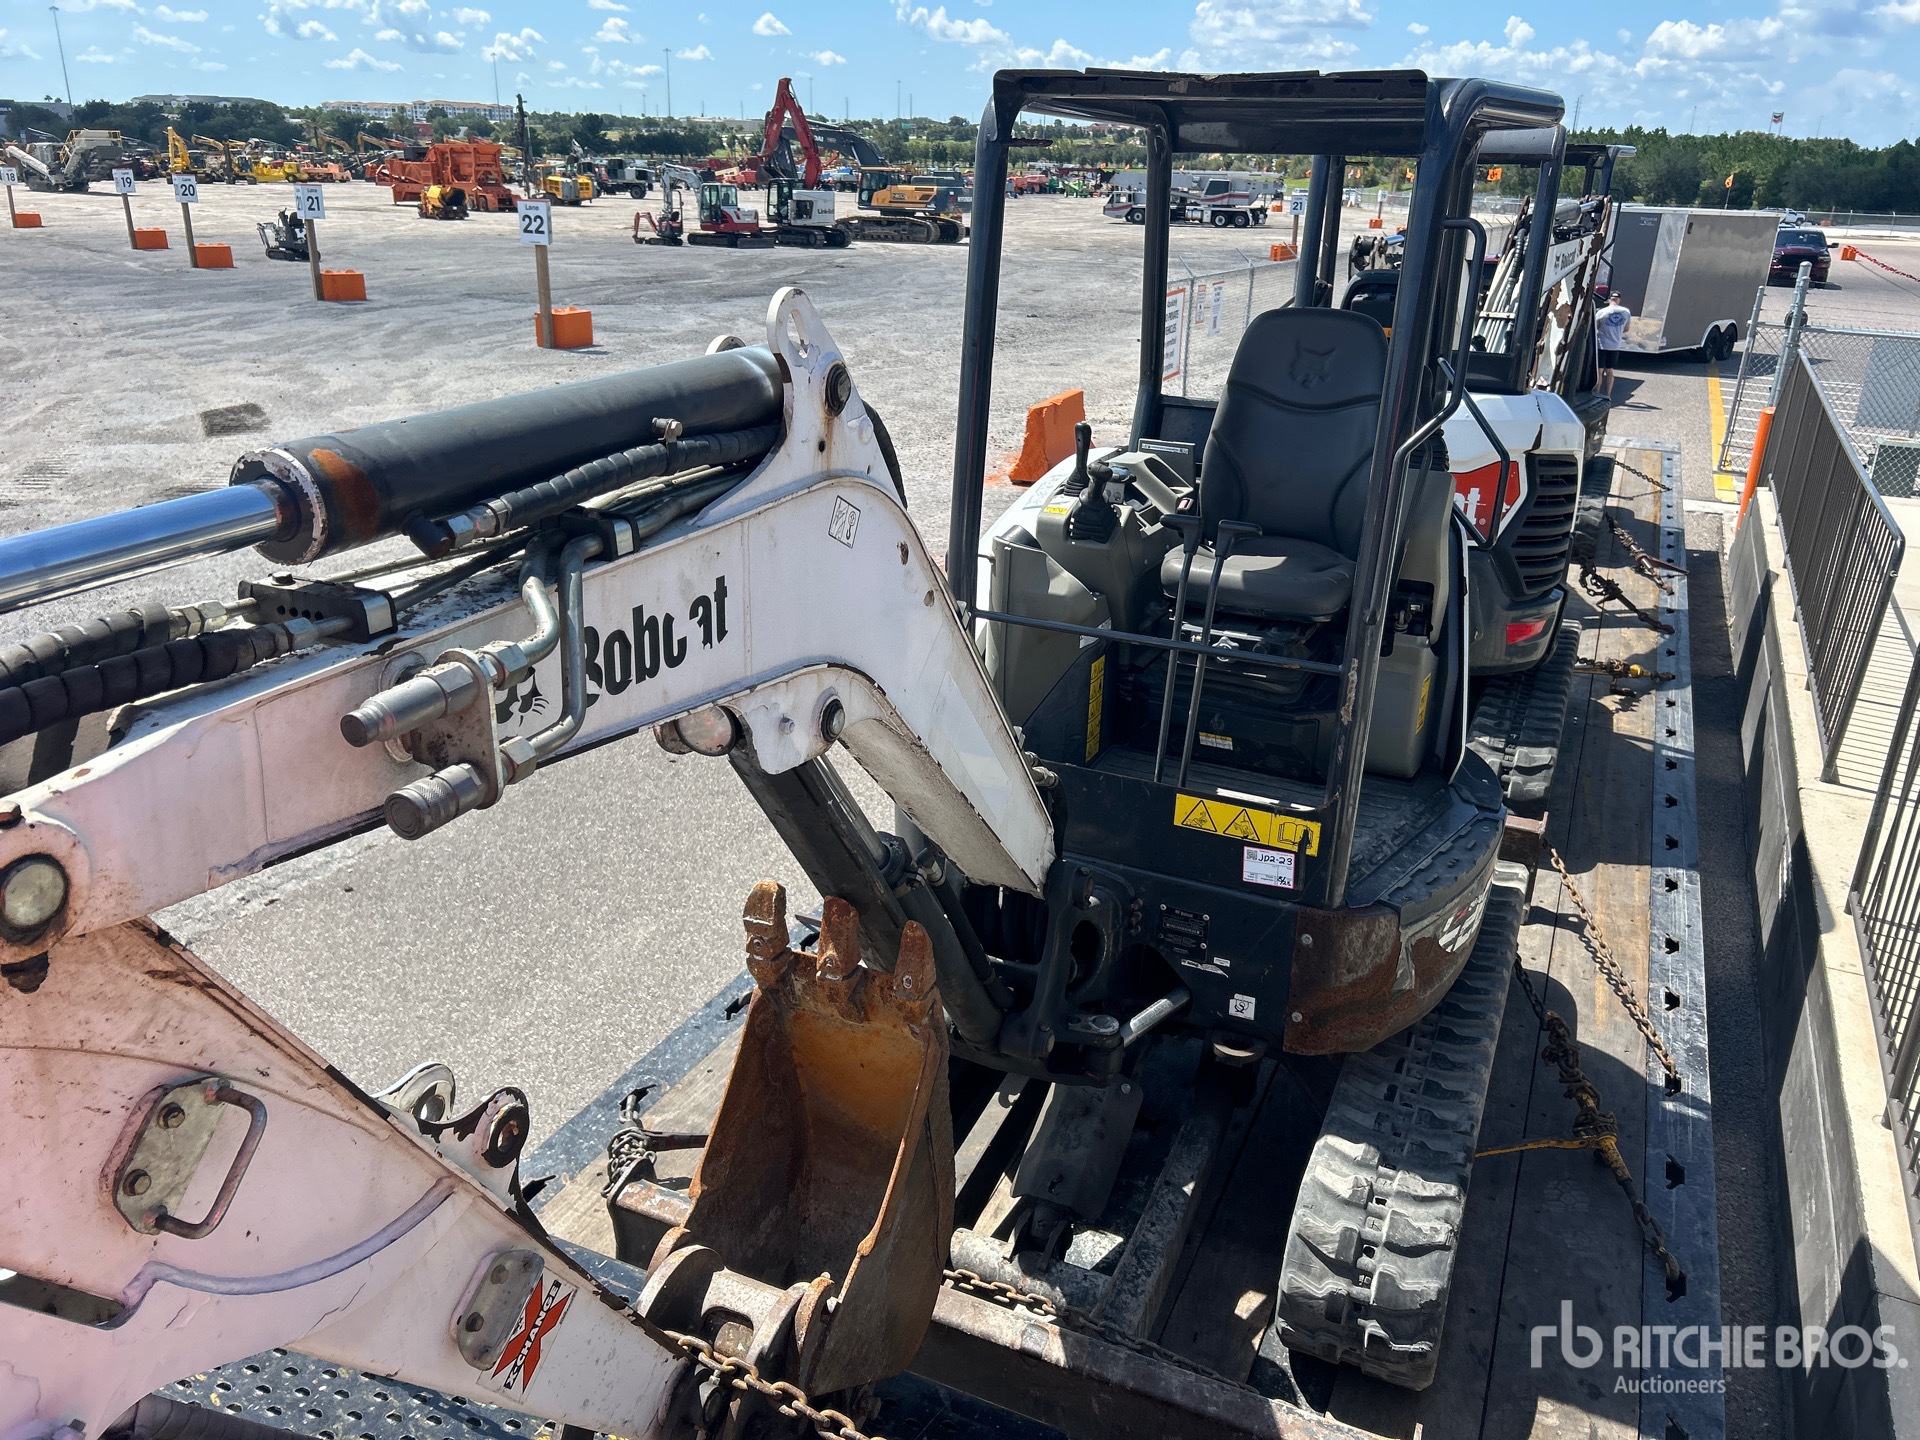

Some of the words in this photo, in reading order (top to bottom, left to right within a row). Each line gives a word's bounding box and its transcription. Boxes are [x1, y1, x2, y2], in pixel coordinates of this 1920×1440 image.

[6, 172, 16, 181] 18
[120, 176, 132, 188] 19
[180, 184, 195, 197] 20
[306, 195, 321, 211] 21
[1292, 201, 1303, 211] 21
[521, 214, 546, 235] 22
[584, 575, 729, 709] Bobcat
